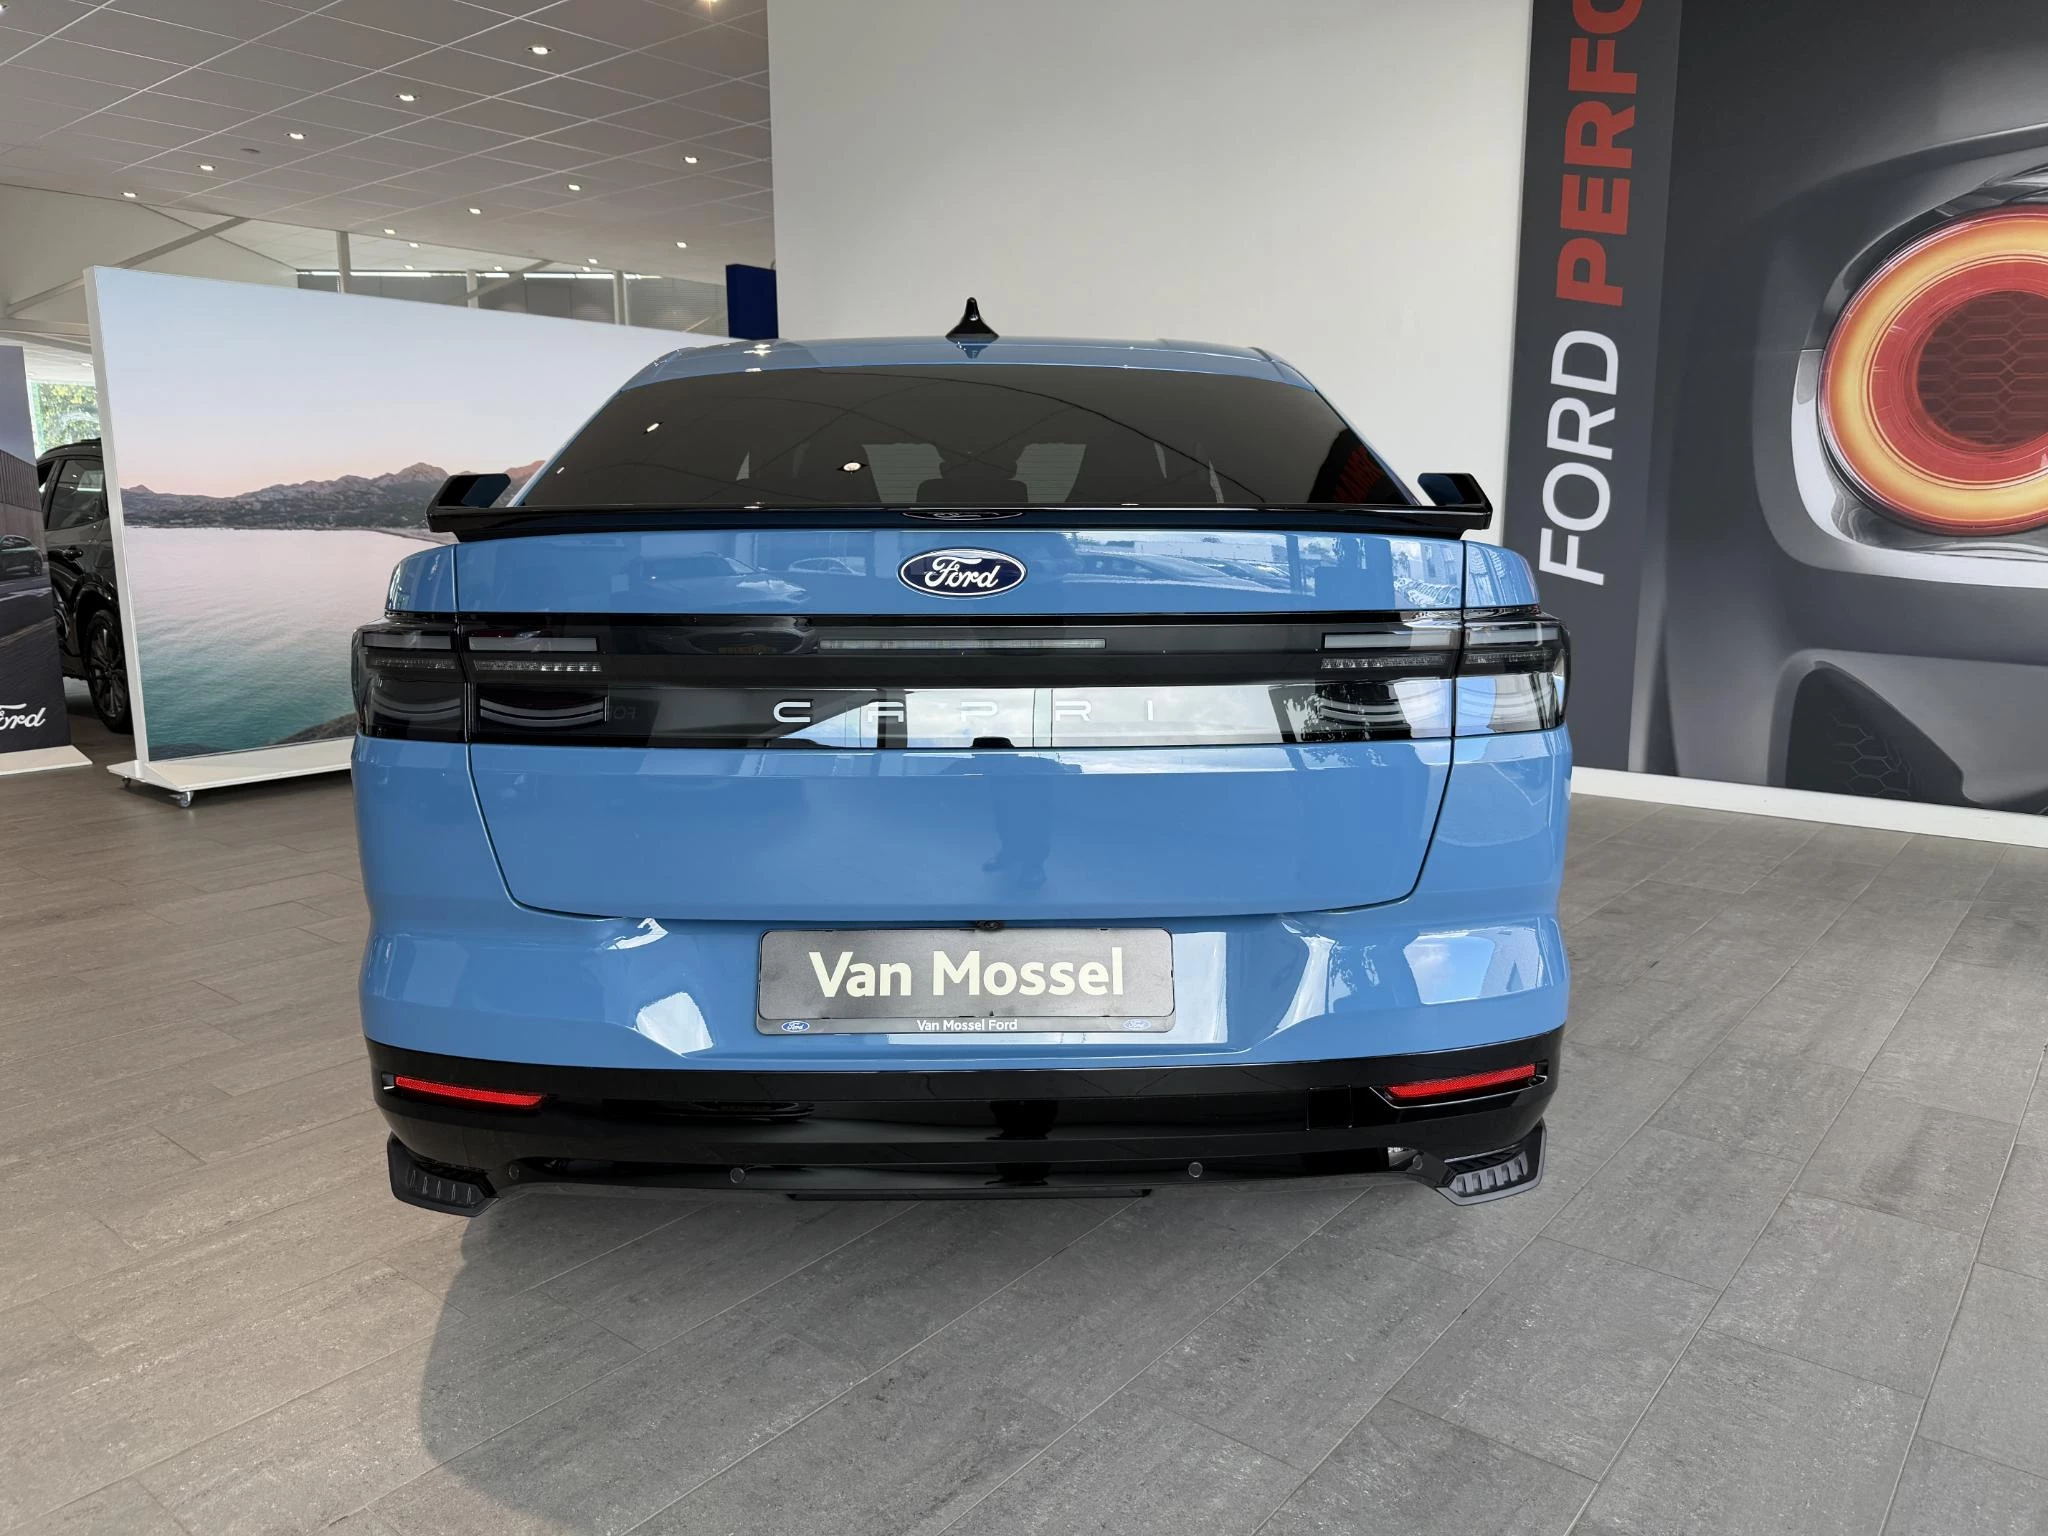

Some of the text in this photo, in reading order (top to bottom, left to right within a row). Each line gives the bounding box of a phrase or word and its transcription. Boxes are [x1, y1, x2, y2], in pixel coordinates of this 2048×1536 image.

[1539, 330, 1619, 586] FORD
[925, 556, 1000, 588] Ford
[772, 700, 1154, 723] CAPRI
[809, 947, 1124, 998] Van Mossel
[917, 1019, 1018, 1031] Van Mossel Ford
